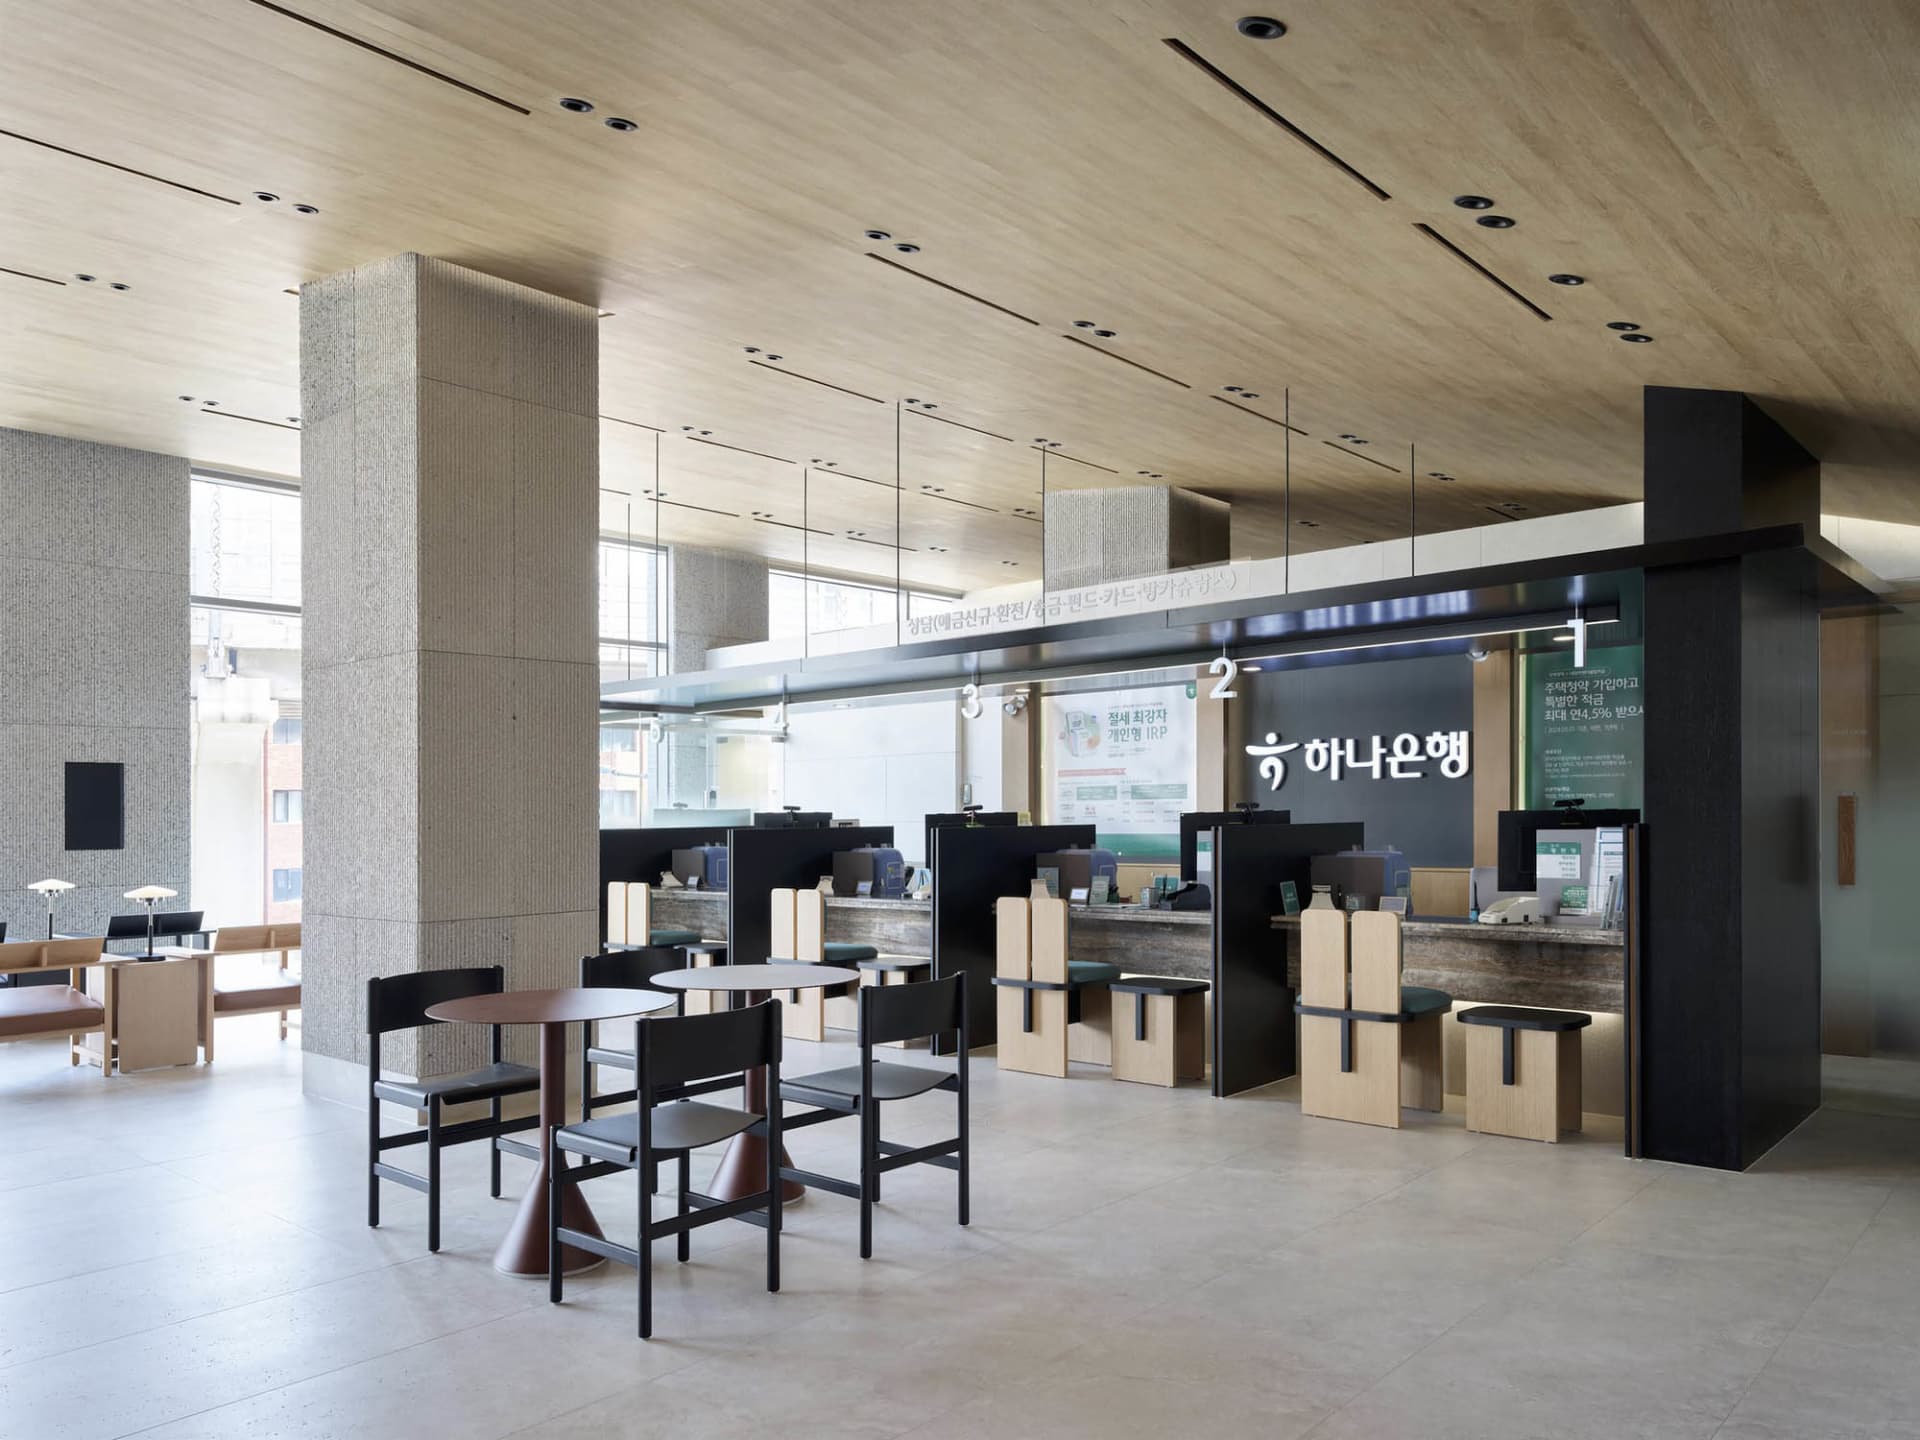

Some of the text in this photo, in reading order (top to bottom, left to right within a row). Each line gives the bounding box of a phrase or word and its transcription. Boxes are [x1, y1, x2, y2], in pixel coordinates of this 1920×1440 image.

[1567, 619, 1585, 668] 1
[1209, 656, 1238, 699] 2
[961, 683, 983, 719] 3
[1582, 693, 1605, 706] 적금
[1108, 708, 1168, 727] 절세 최강자
[1544, 708, 1567, 722] 최대
[1569, 707, 1613, 721] 연4.5%
[1107, 725, 1169, 743] 개인형 IRP
[1304, 730, 1470, 781] 하나은행
